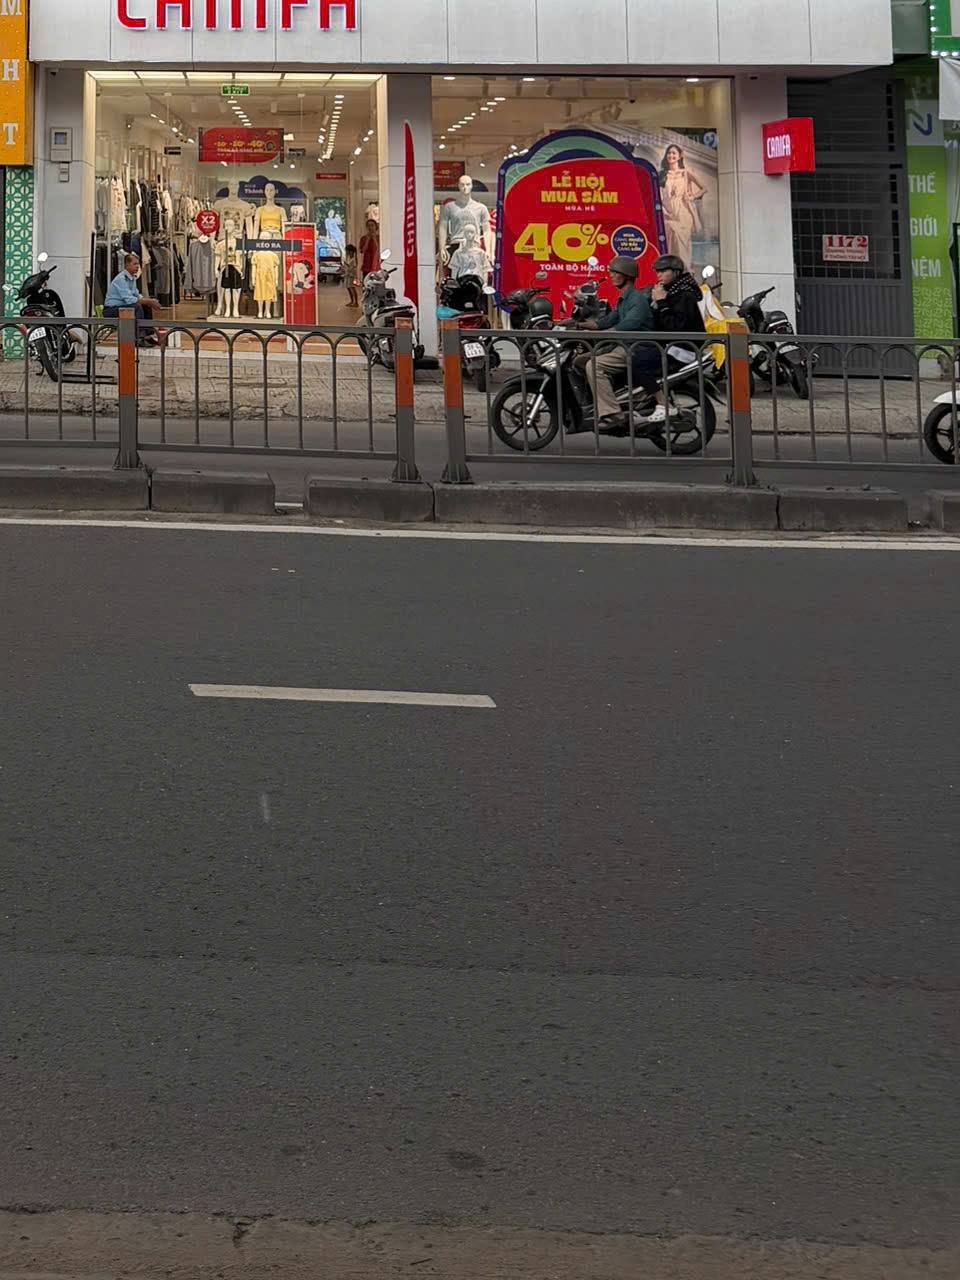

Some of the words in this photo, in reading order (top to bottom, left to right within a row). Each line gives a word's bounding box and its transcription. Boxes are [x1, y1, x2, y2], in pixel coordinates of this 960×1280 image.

[766, 134, 791, 159] CANIFA
[575, 173, 605, 190] HỘI
[907, 171, 936, 194] THẾ
[541, 191, 578, 204] MUA
[581, 187, 619, 204] SẮM
[201, 215, 216, 224] X2
[909, 214, 938, 237] GIỚI
[255, 241, 271, 249] KÉO
[826, 236, 868, 248] 1172
[540, 263, 564, 271] TOÀN
[565, 263, 579, 272] BỘ
